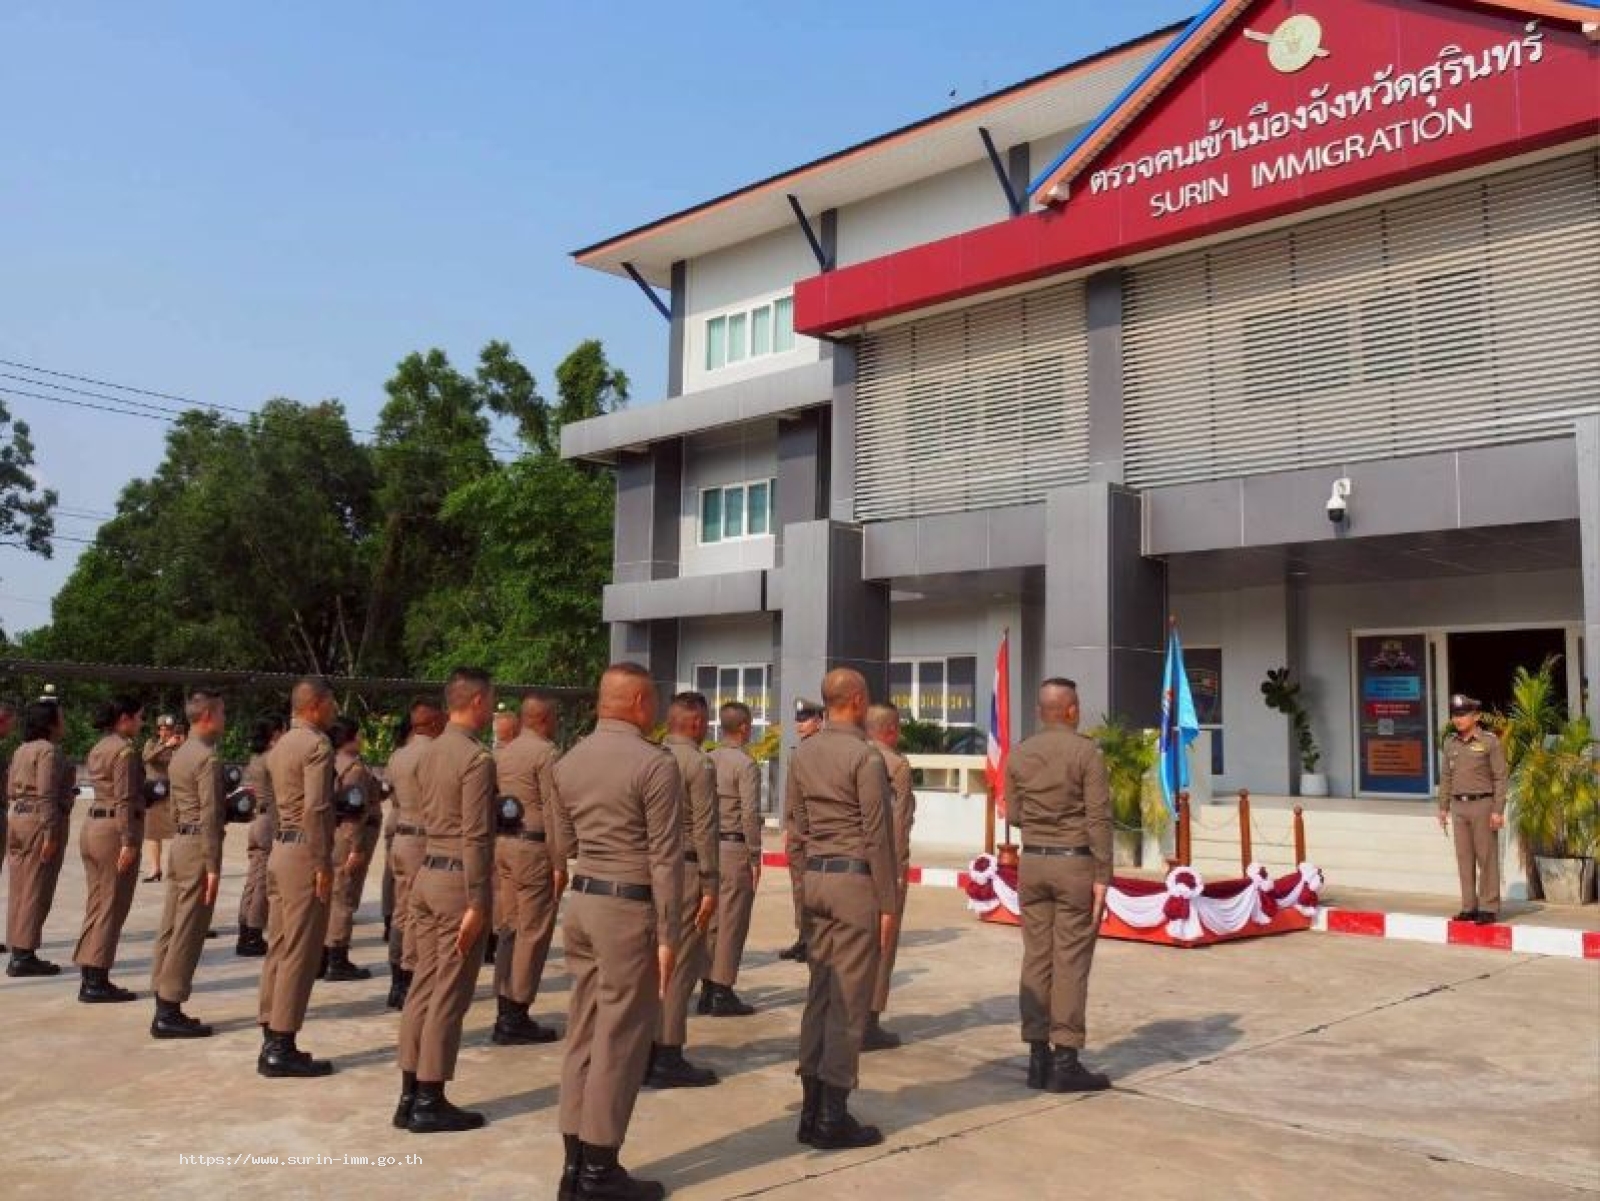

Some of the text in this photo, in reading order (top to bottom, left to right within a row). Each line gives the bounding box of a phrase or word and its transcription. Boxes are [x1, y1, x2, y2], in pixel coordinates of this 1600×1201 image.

[1089, 20, 1543, 195] ตรวจคนเข้าเมืองจังหวัดสุรินทร์
[1150, 103, 1473, 217] SURIN IMMIGRATION
